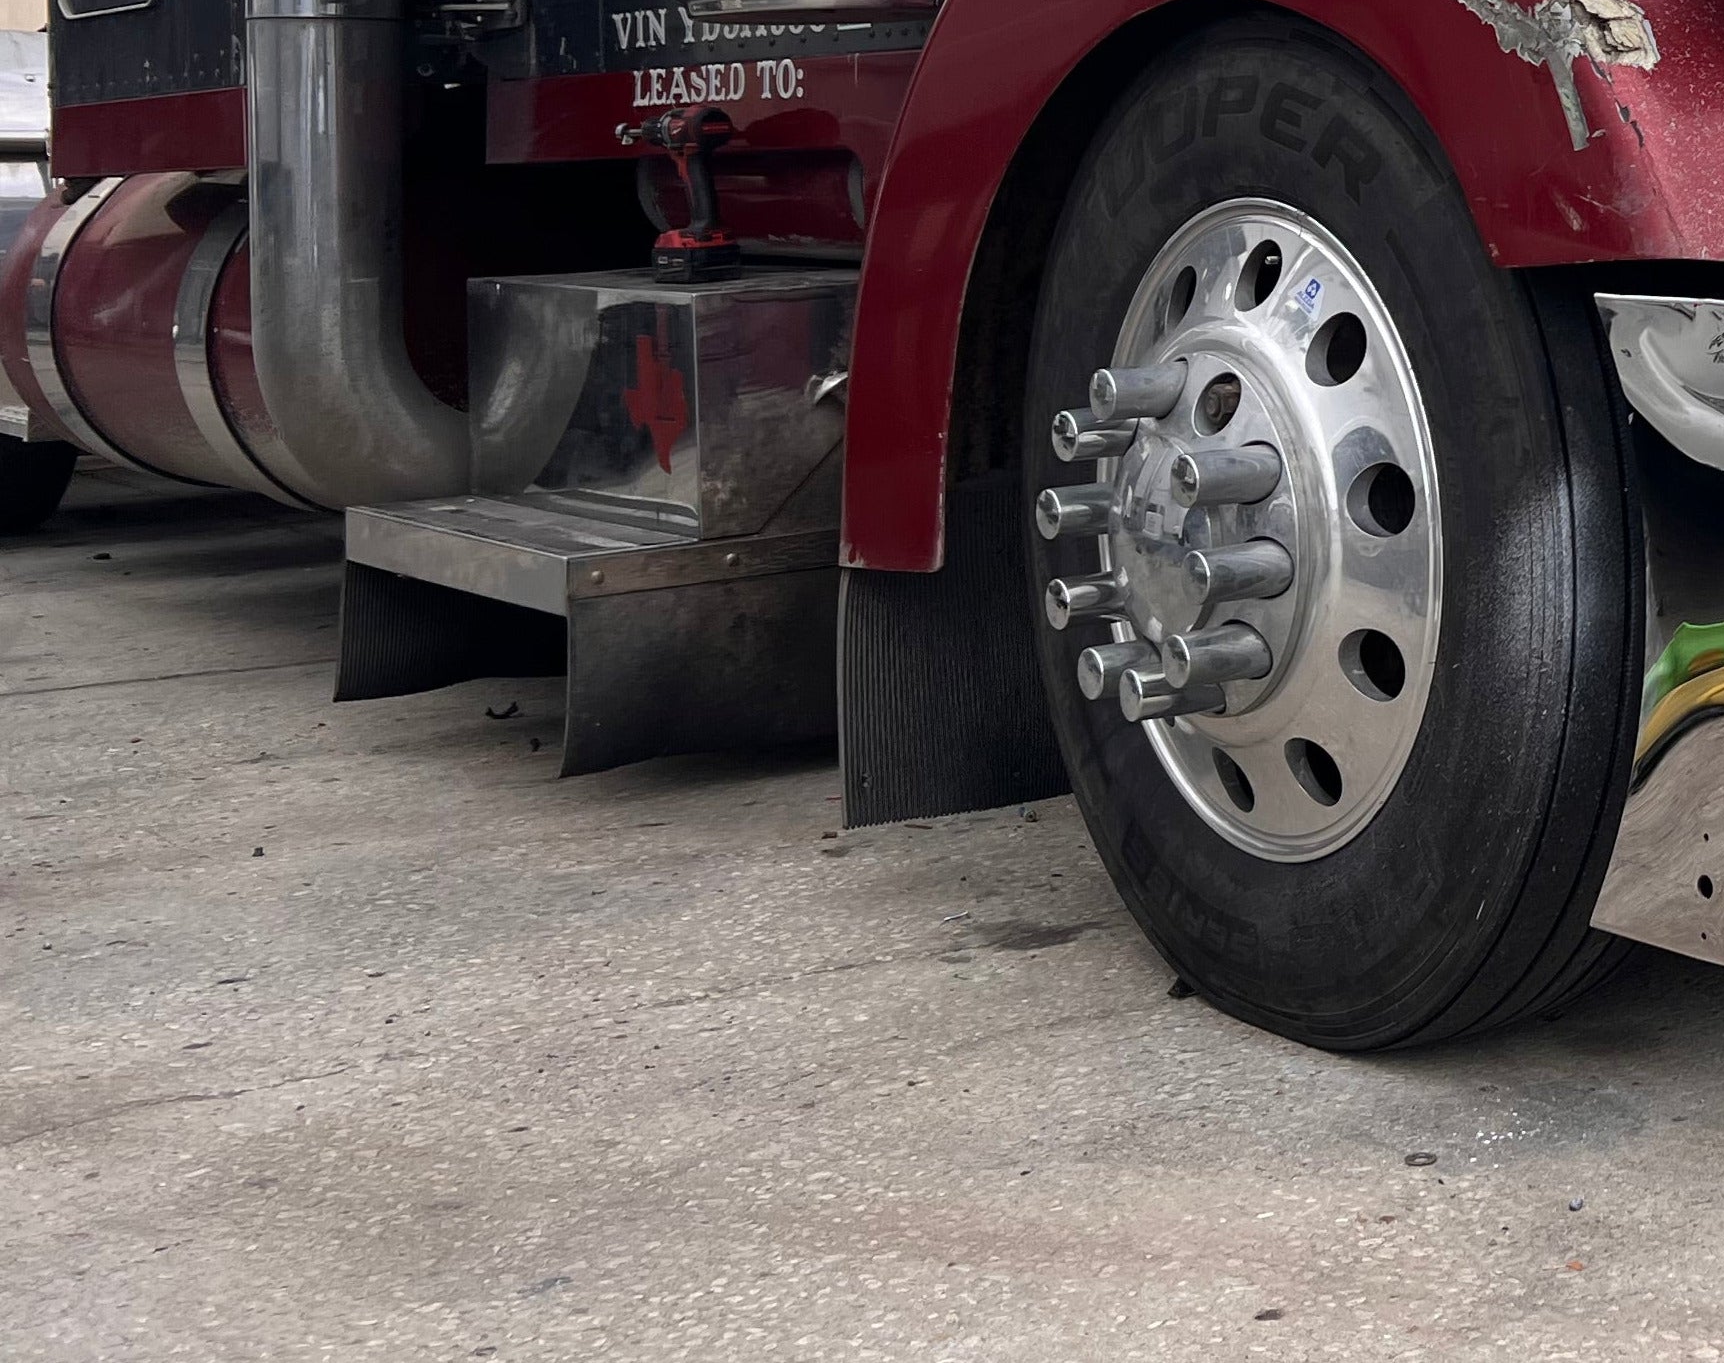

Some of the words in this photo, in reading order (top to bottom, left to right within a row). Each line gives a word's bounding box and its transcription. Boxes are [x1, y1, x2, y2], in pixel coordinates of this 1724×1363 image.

[612, 8, 668, 50] VIN
[633, 62, 746, 107] LEASED
[756, 58, 805, 101] TO:
